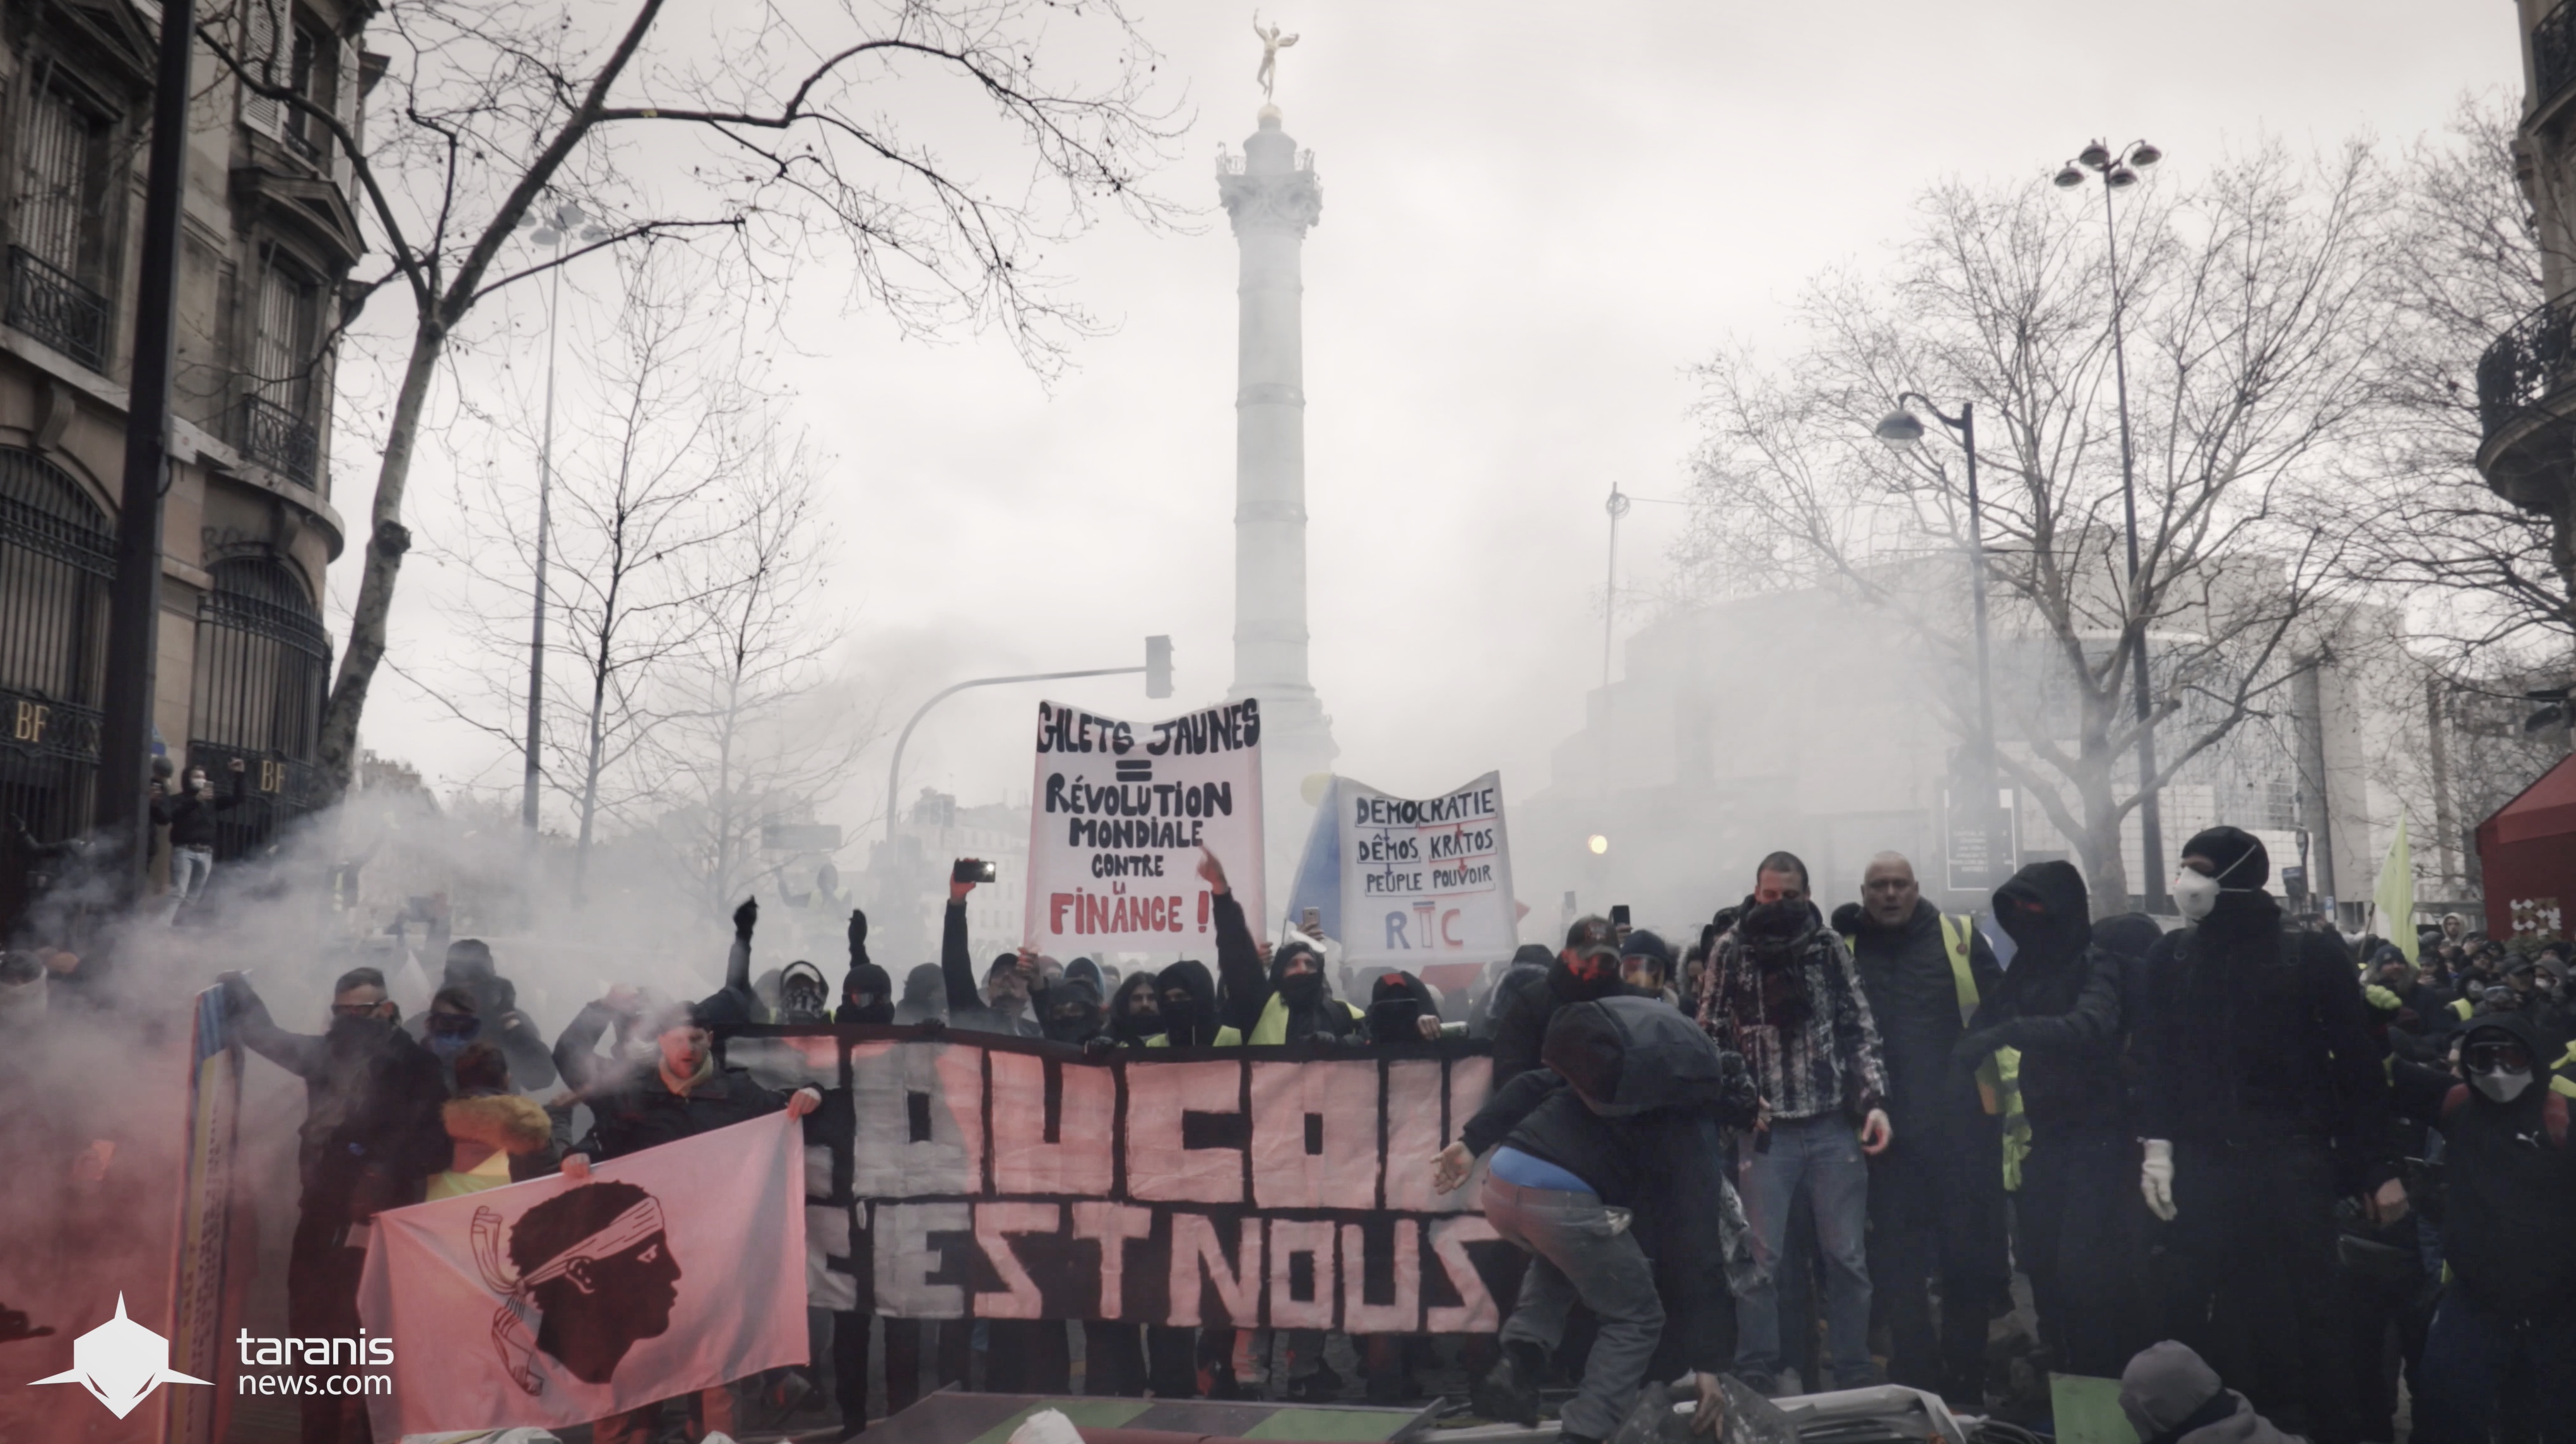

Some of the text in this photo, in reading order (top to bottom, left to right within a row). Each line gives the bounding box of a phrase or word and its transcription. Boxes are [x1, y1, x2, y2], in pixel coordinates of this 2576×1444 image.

[15, 701, 49, 742] BF
[1037, 698, 1260, 755] GILETS JAUNES
[261, 760, 287, 793] BF
[1046, 772, 1232, 817] RÉVOLUTION
[1069, 817, 1203, 849] MONDIALE
[1359, 829, 1493, 861] DÊMOS KRATOS
[1091, 854, 1164, 878] CONTRE
[1366, 865, 1492, 893] PEUPLE POUVOIR
[1113, 881, 1126, 894] LA
[1050, 887, 1210, 935] FINANCE !
[1385, 901, 1463, 949] RTC
